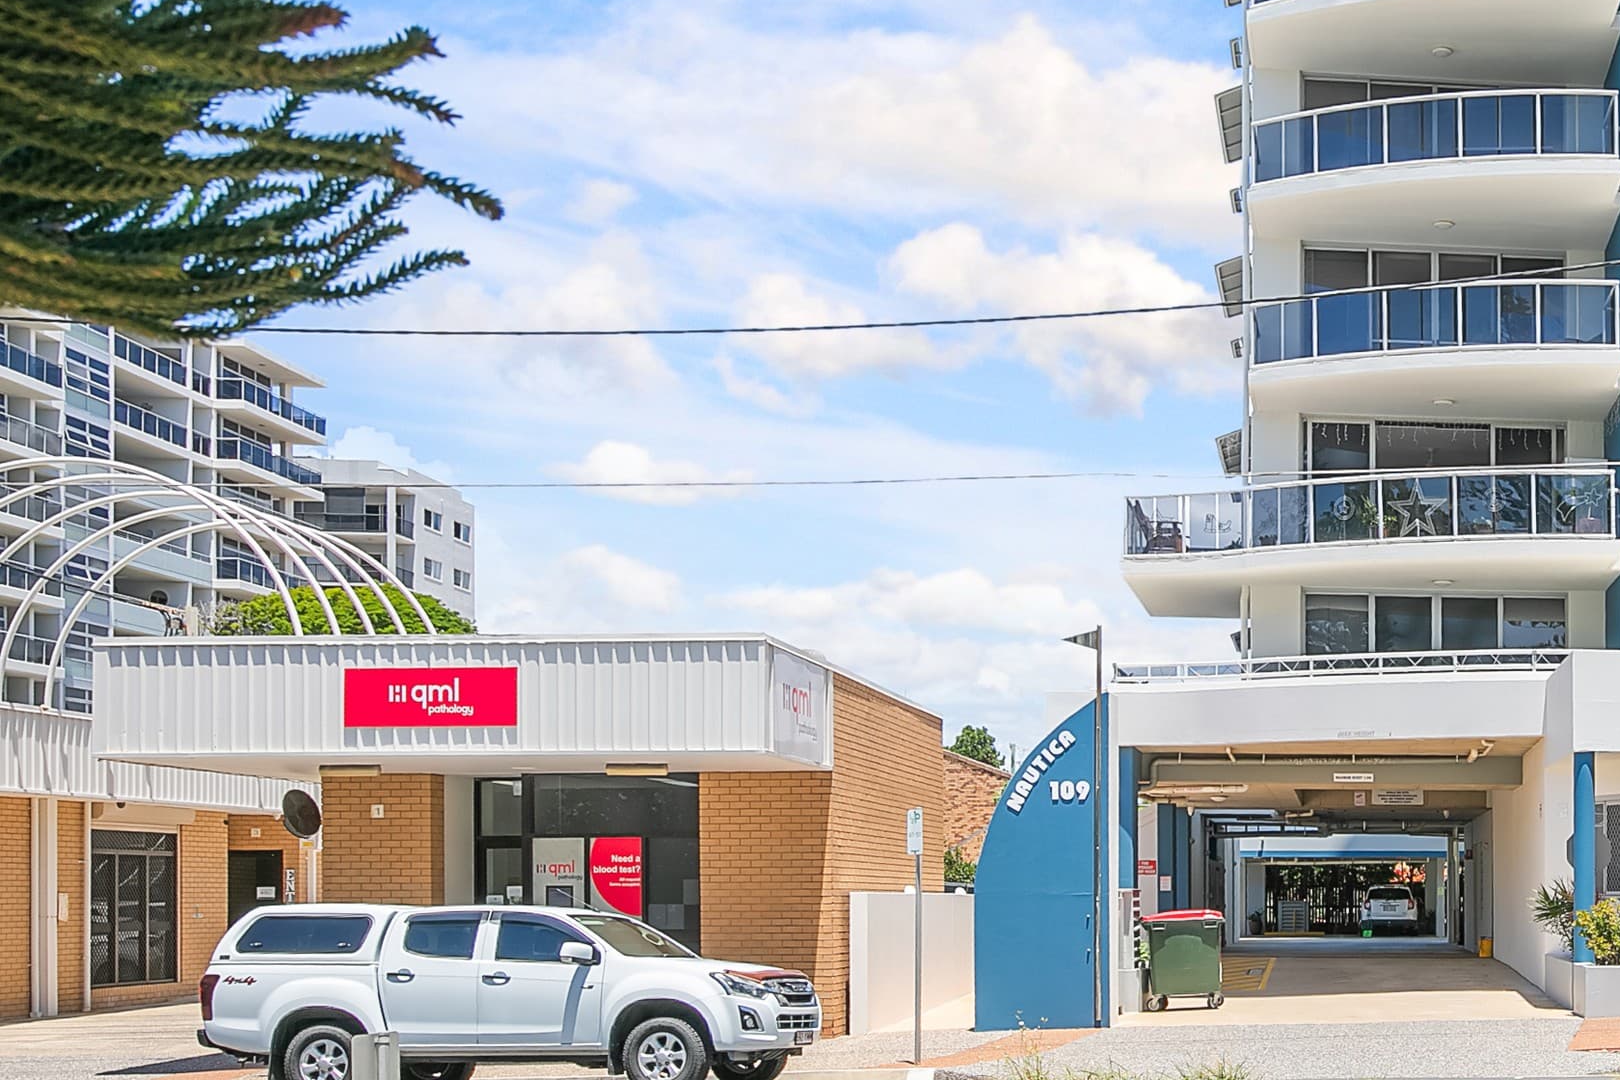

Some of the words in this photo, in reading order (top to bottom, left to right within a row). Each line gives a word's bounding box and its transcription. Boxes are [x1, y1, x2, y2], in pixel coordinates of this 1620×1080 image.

[411, 677, 460, 709] qml
[428, 704, 474, 716] pathology
[1006, 730, 1077, 813] NAUTICA
[1049, 781, 1091, 801] 109
[611, 854, 633, 863] Need
[549, 861, 575, 877] qml
[593, 866, 618, 874] blood
